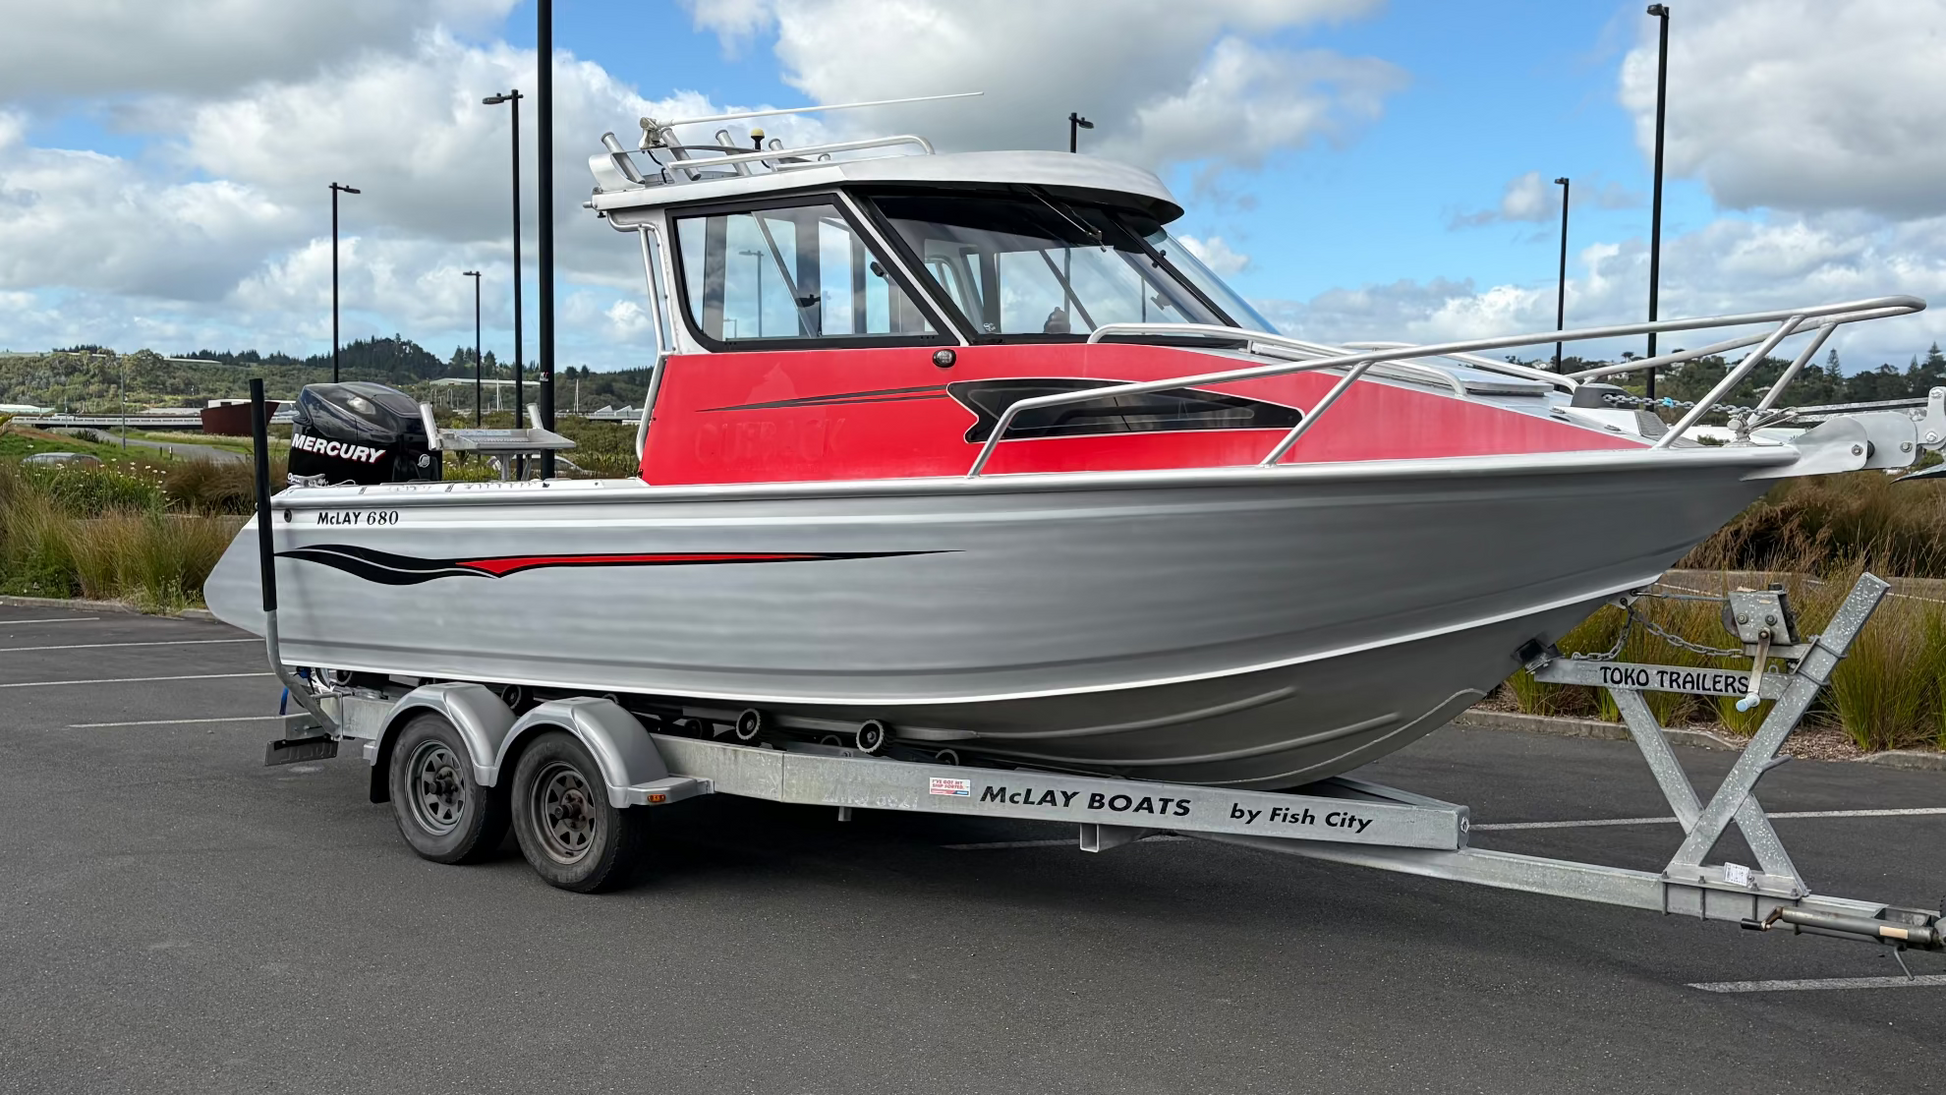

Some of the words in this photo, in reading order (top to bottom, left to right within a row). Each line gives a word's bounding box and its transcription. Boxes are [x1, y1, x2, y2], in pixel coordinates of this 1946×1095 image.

[291, 432, 386, 464] MERCURY
[317, 511, 362, 525] McLAY
[366, 511, 399, 526] 680
[1600, 666, 1649, 687] TOKO
[1656, 670, 1749, 695] TRAILERS
[979, 785, 1080, 808] McLAY
[1087, 792, 1192, 817] BOATS
[1229, 802, 1263, 825] by
[1269, 806, 1315, 825] Fish
[1325, 811, 1374, 834] City
